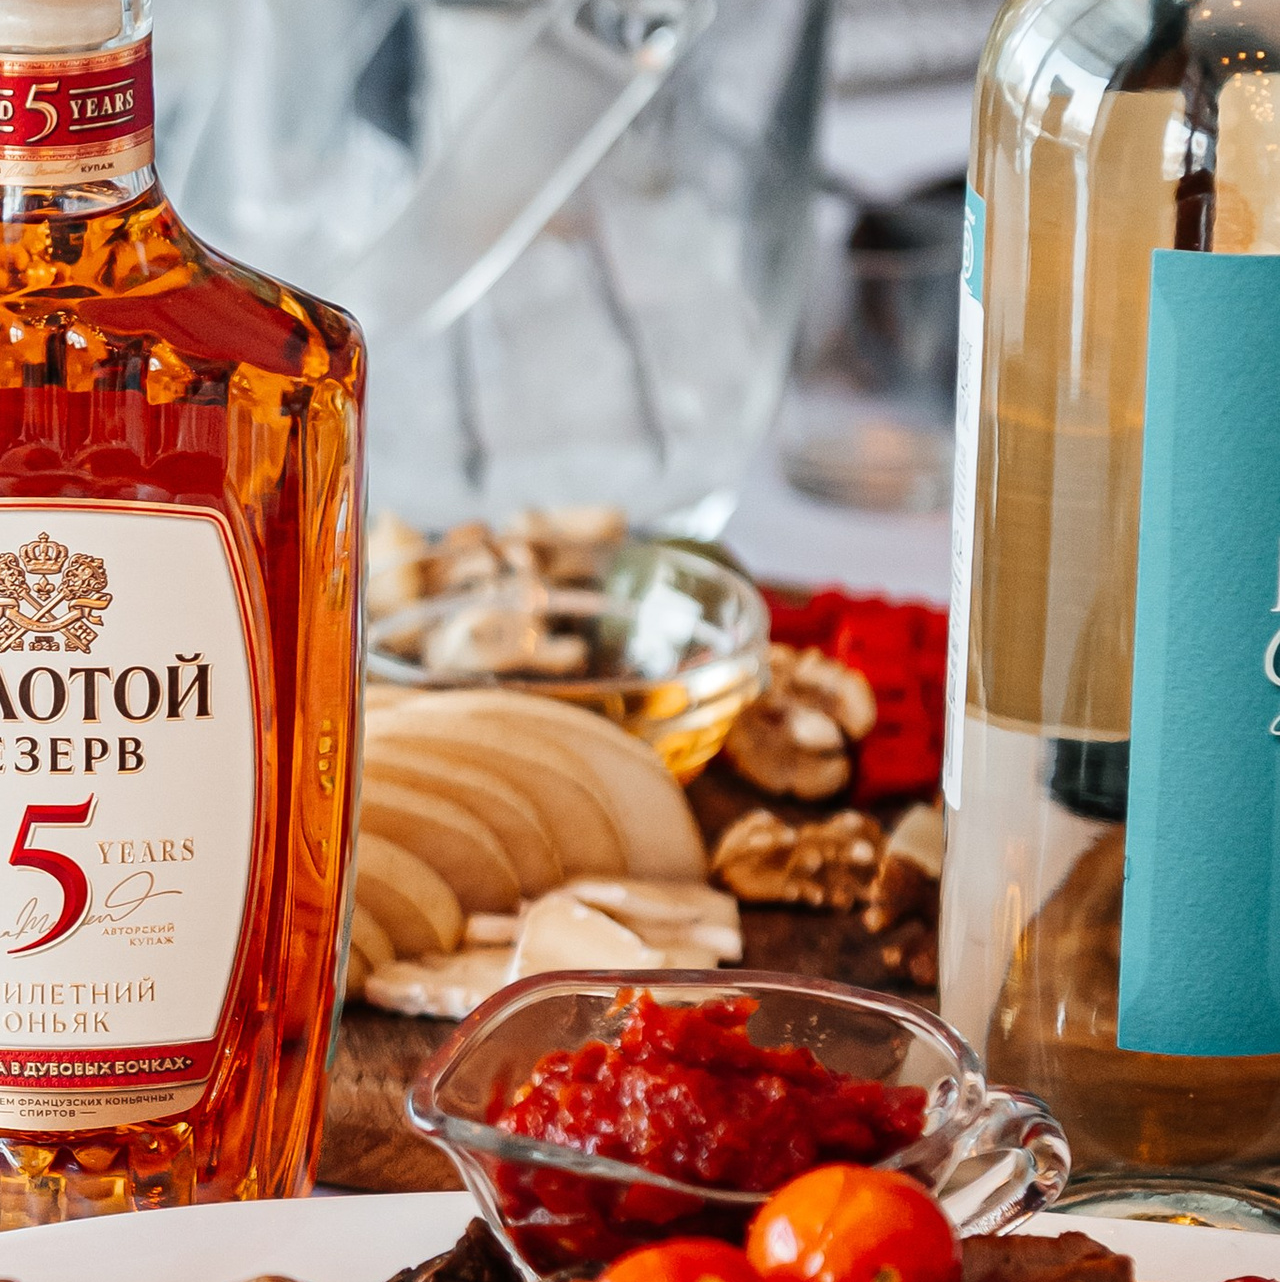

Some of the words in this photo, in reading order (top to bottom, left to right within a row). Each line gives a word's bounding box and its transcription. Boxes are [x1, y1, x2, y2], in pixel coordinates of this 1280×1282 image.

[25, 80, 60, 143] 5
[70, 89, 134, 119] YEARS
[81, 162, 115, 173] КУПАЖ
[7, 792, 99, 959] 5
[95, 836, 195, 865] YEARS
[102, 922, 176, 936] АВТОРСКИЙ
[129, 936, 176, 946] КУПАЖ
[10, 1061, 21, 1076] В
[23, 1061, 112, 1078] ДУБОВЫХ
[114, 1056, 186, 1075] БОЧКАХ
[17, 1098, 103, 1107] ФРАНЦУЗСКИХ
[105, 1093, 175, 1105] КОНЬЯЧНЫХ
[19, 1109, 76, 1117] СПИРТОВ
